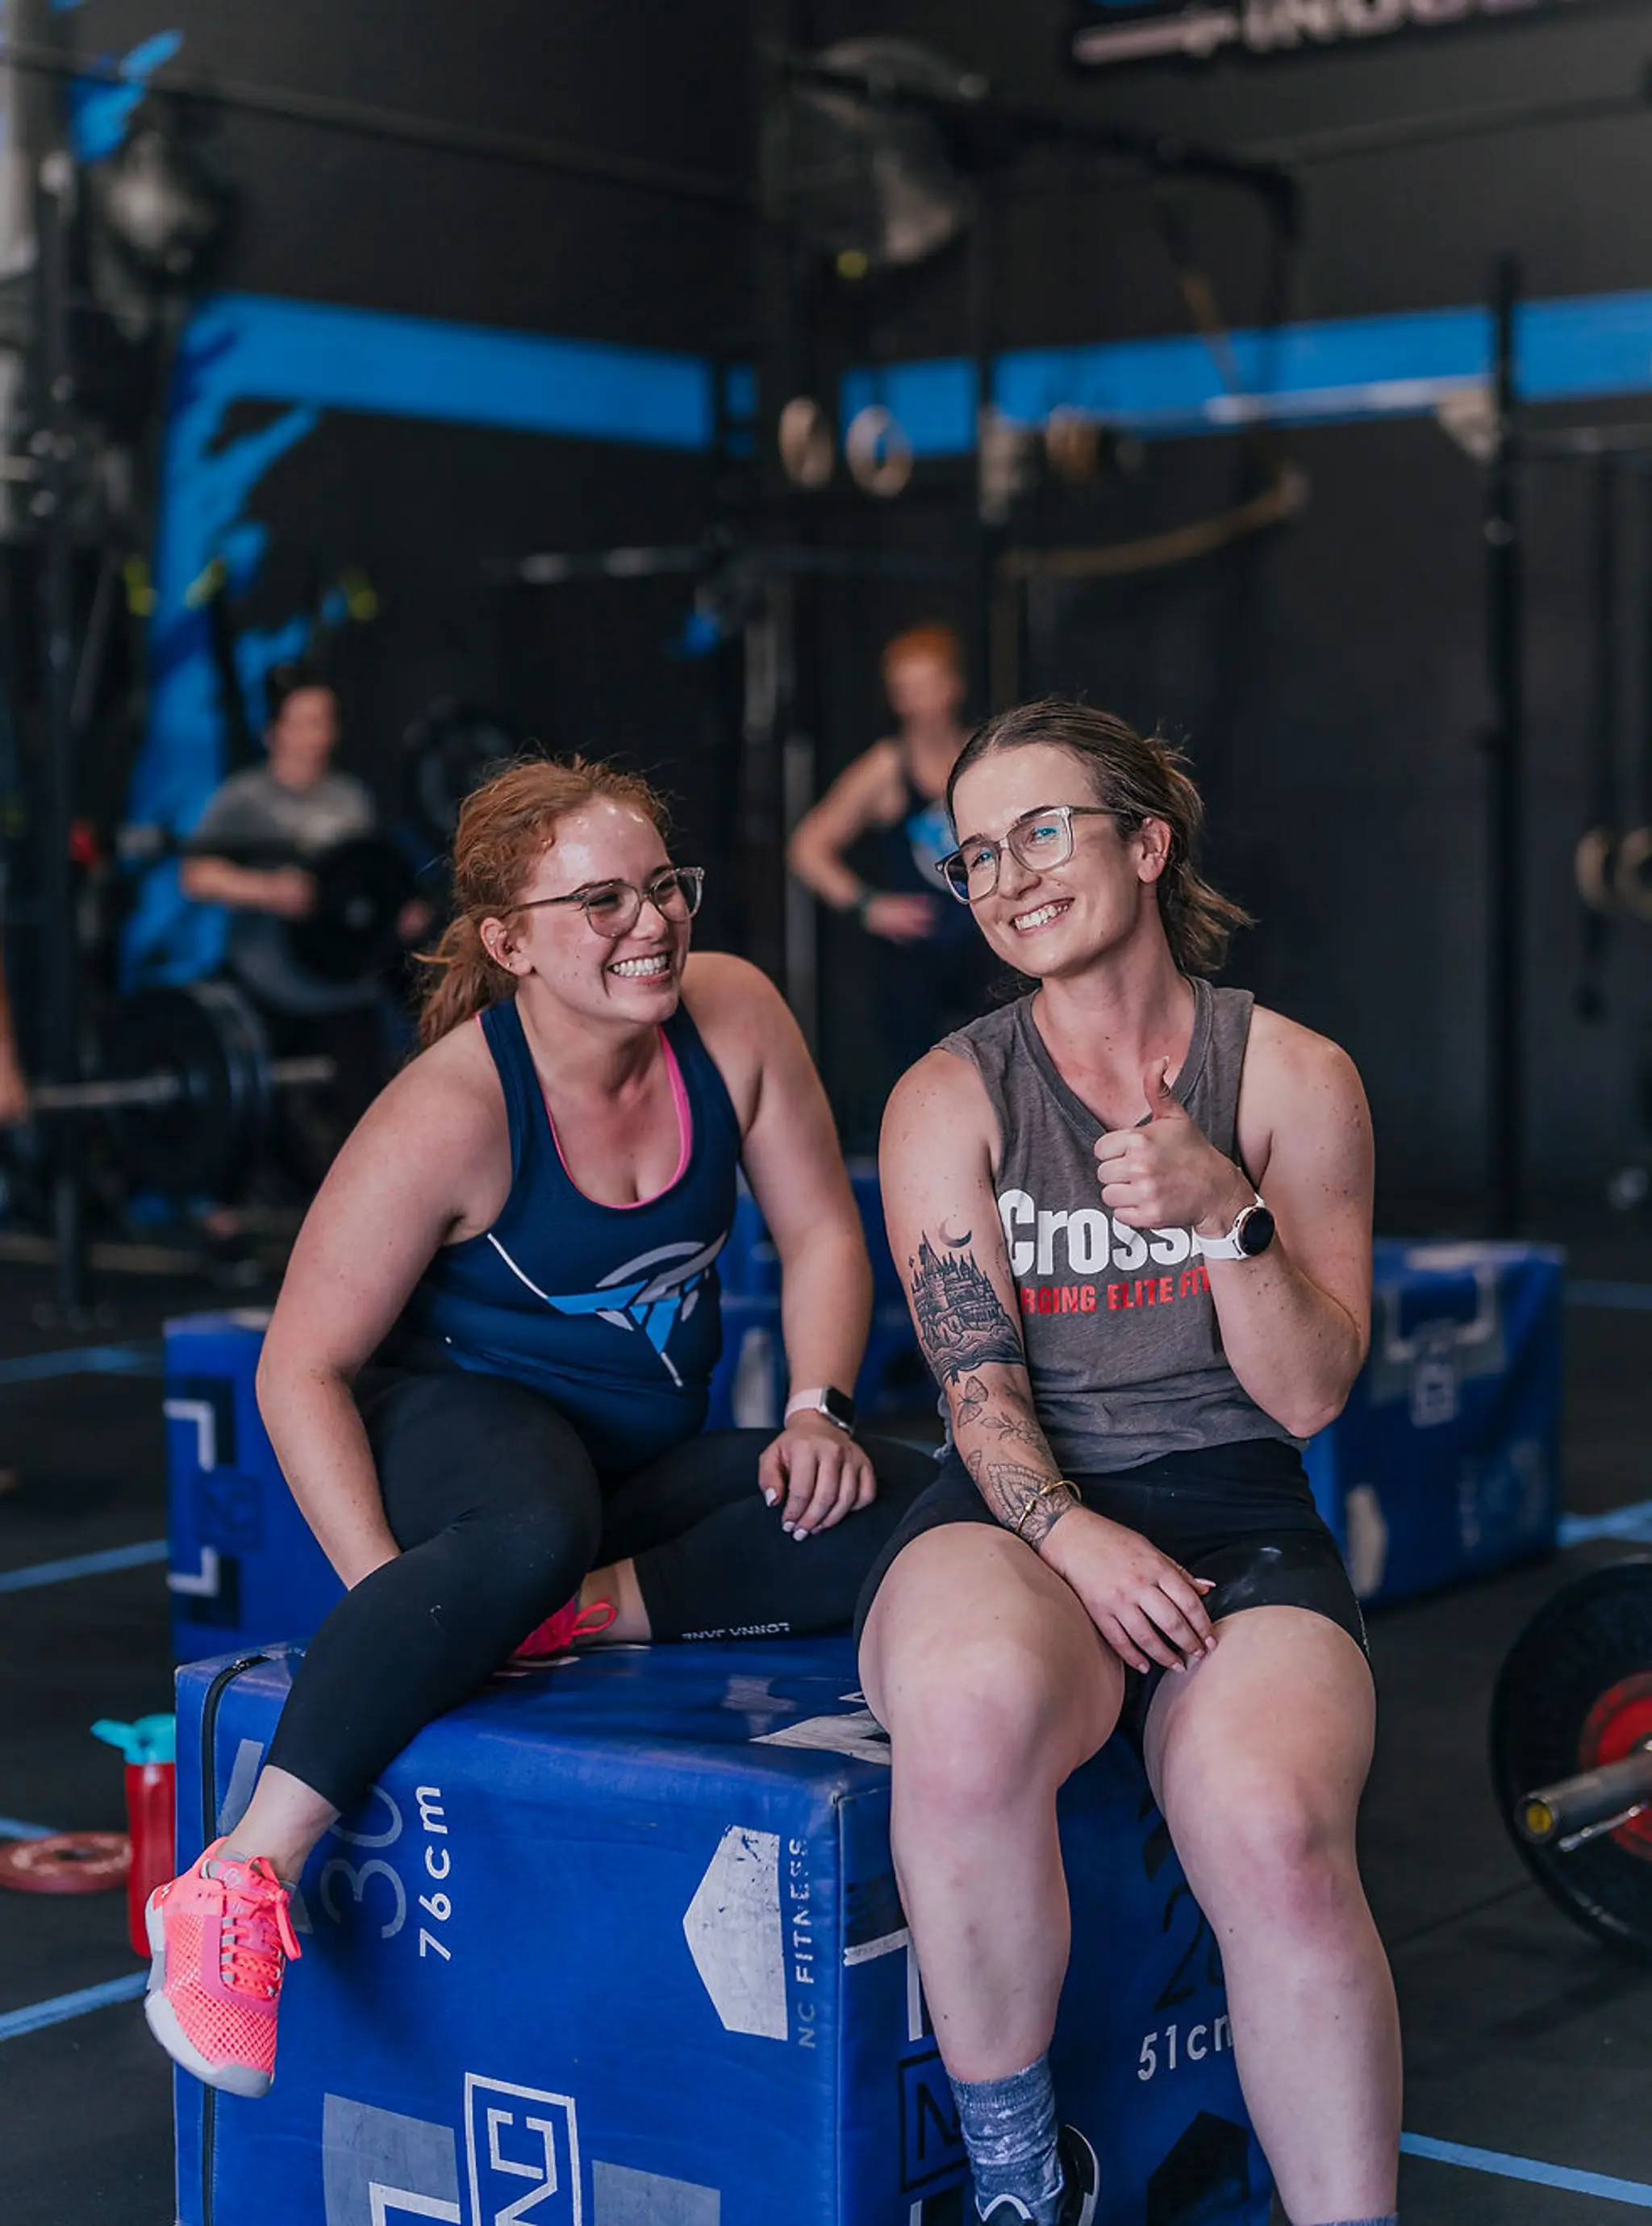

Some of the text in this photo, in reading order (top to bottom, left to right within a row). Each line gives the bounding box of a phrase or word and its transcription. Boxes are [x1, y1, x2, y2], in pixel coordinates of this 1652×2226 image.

[1020, 1285, 1097, 1314] RGING
[1108, 1277, 1174, 1310] ELITE
[681, 1622, 791, 1640] LORNA JANE
[415, 1785, 452, 1961] 76cm
[1153, 1881, 1225, 2013] 2
[797, 2003, 816, 2049] NC
